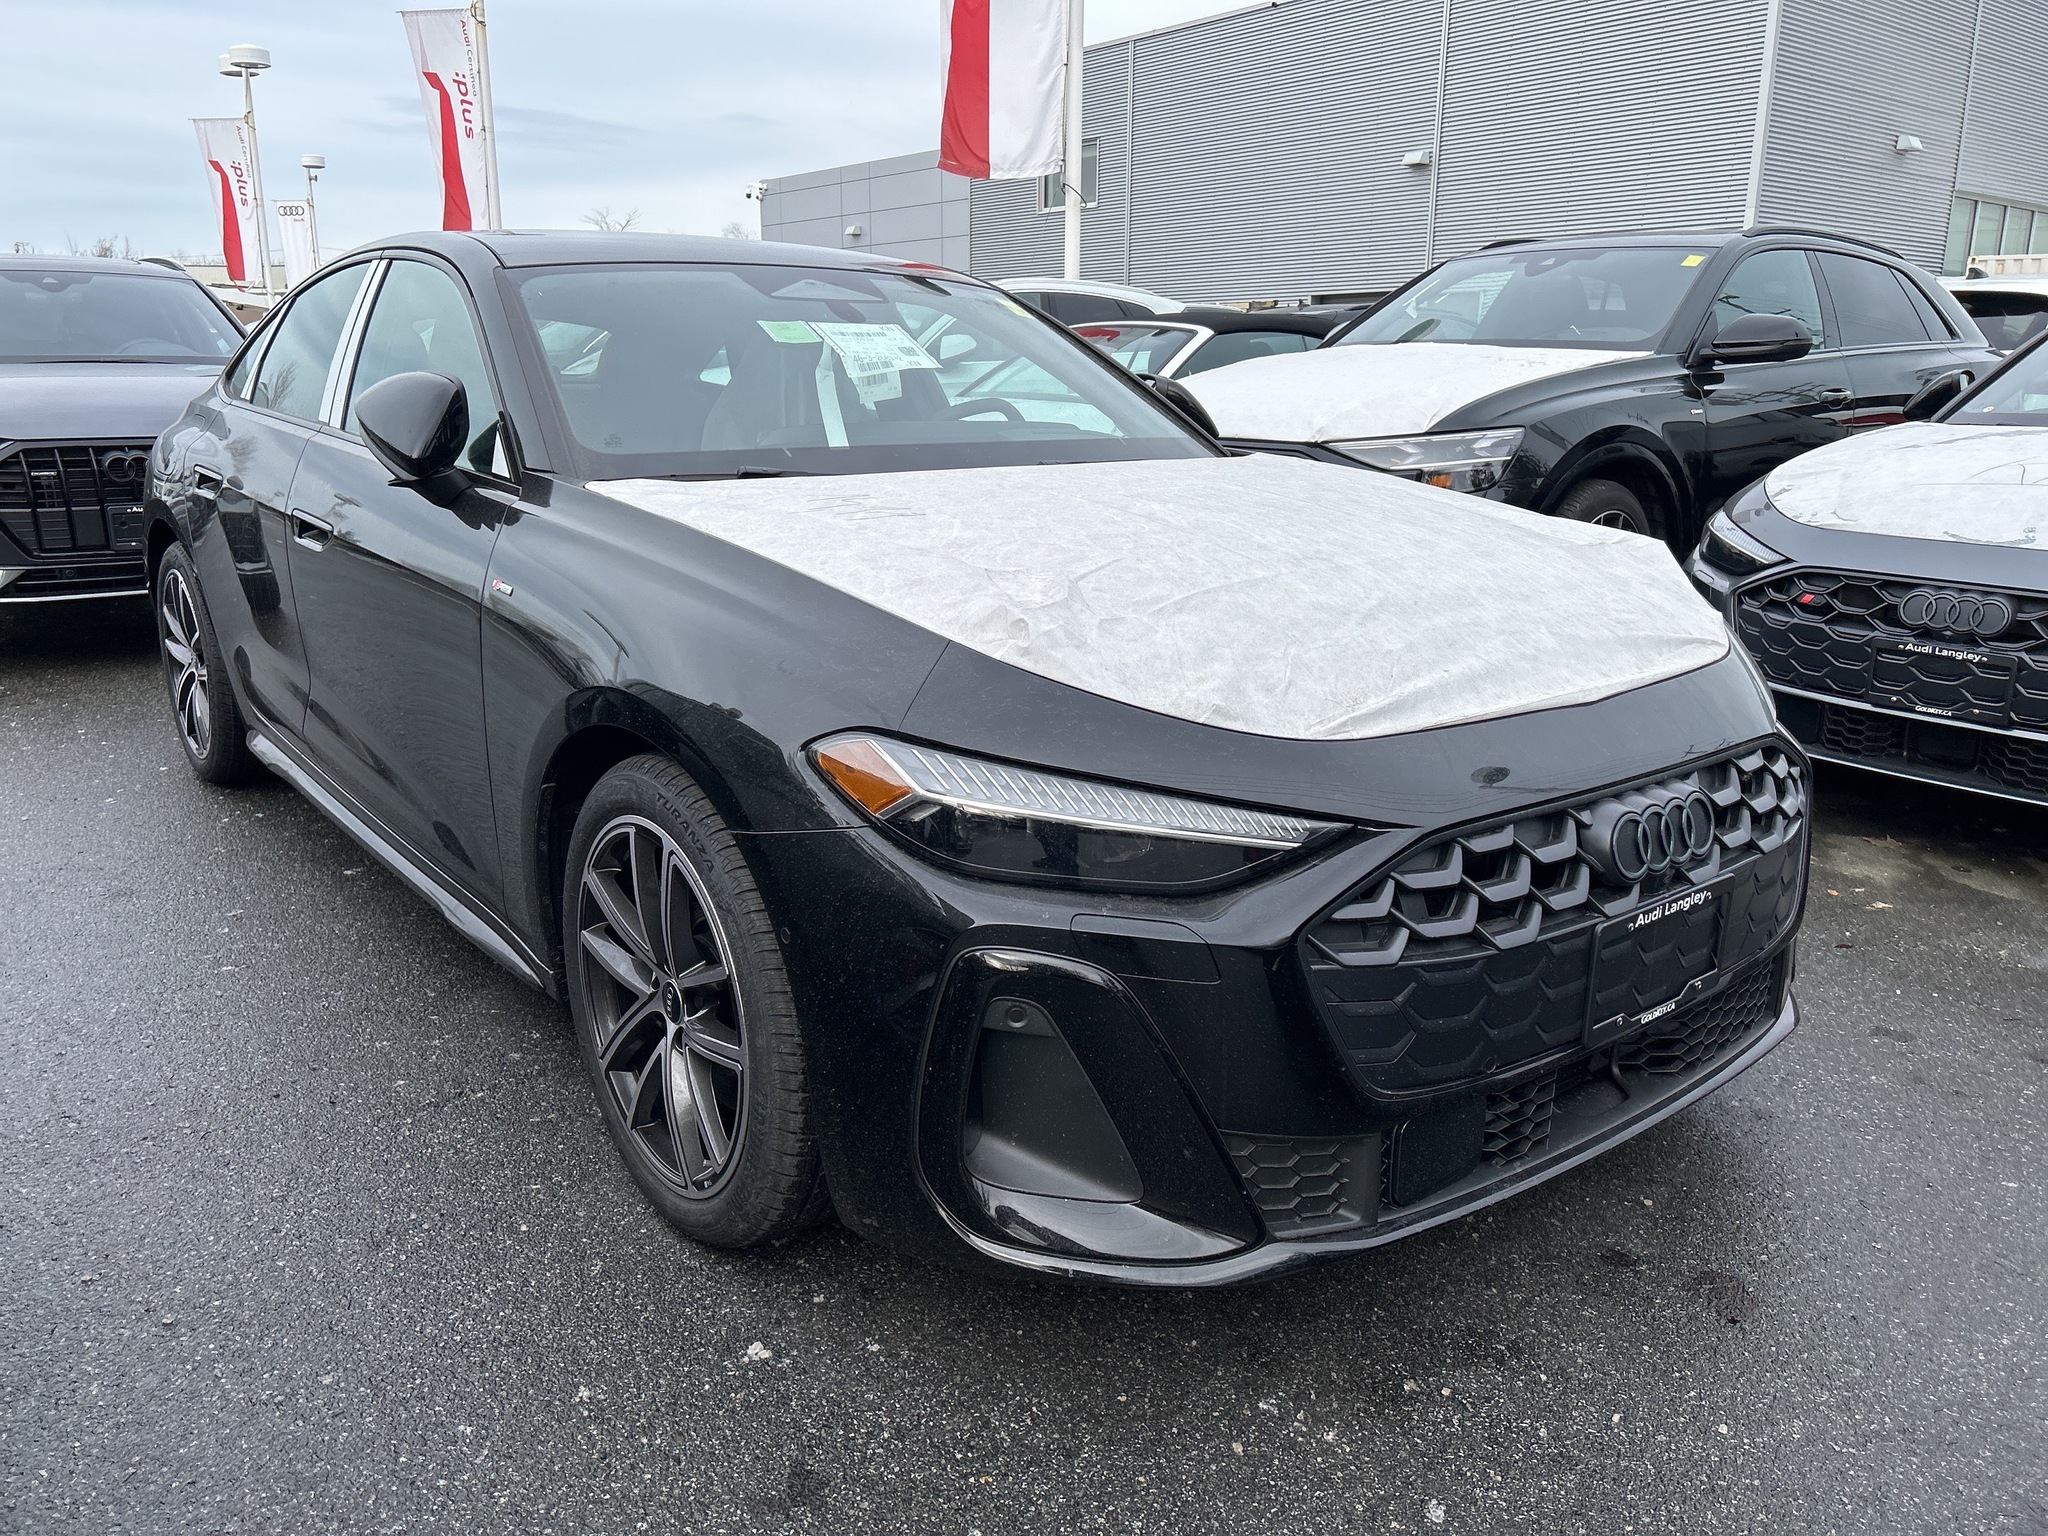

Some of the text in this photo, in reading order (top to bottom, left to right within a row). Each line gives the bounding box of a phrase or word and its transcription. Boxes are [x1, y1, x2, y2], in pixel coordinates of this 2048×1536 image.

[459, 19, 478, 97] Audi Certified
[235, 125, 246, 144] Audi
[1904, 642, 1982, 663] Audi Langley
[656, 791, 715, 874] TURANZA
[1634, 890, 1708, 928] Audi Langley
